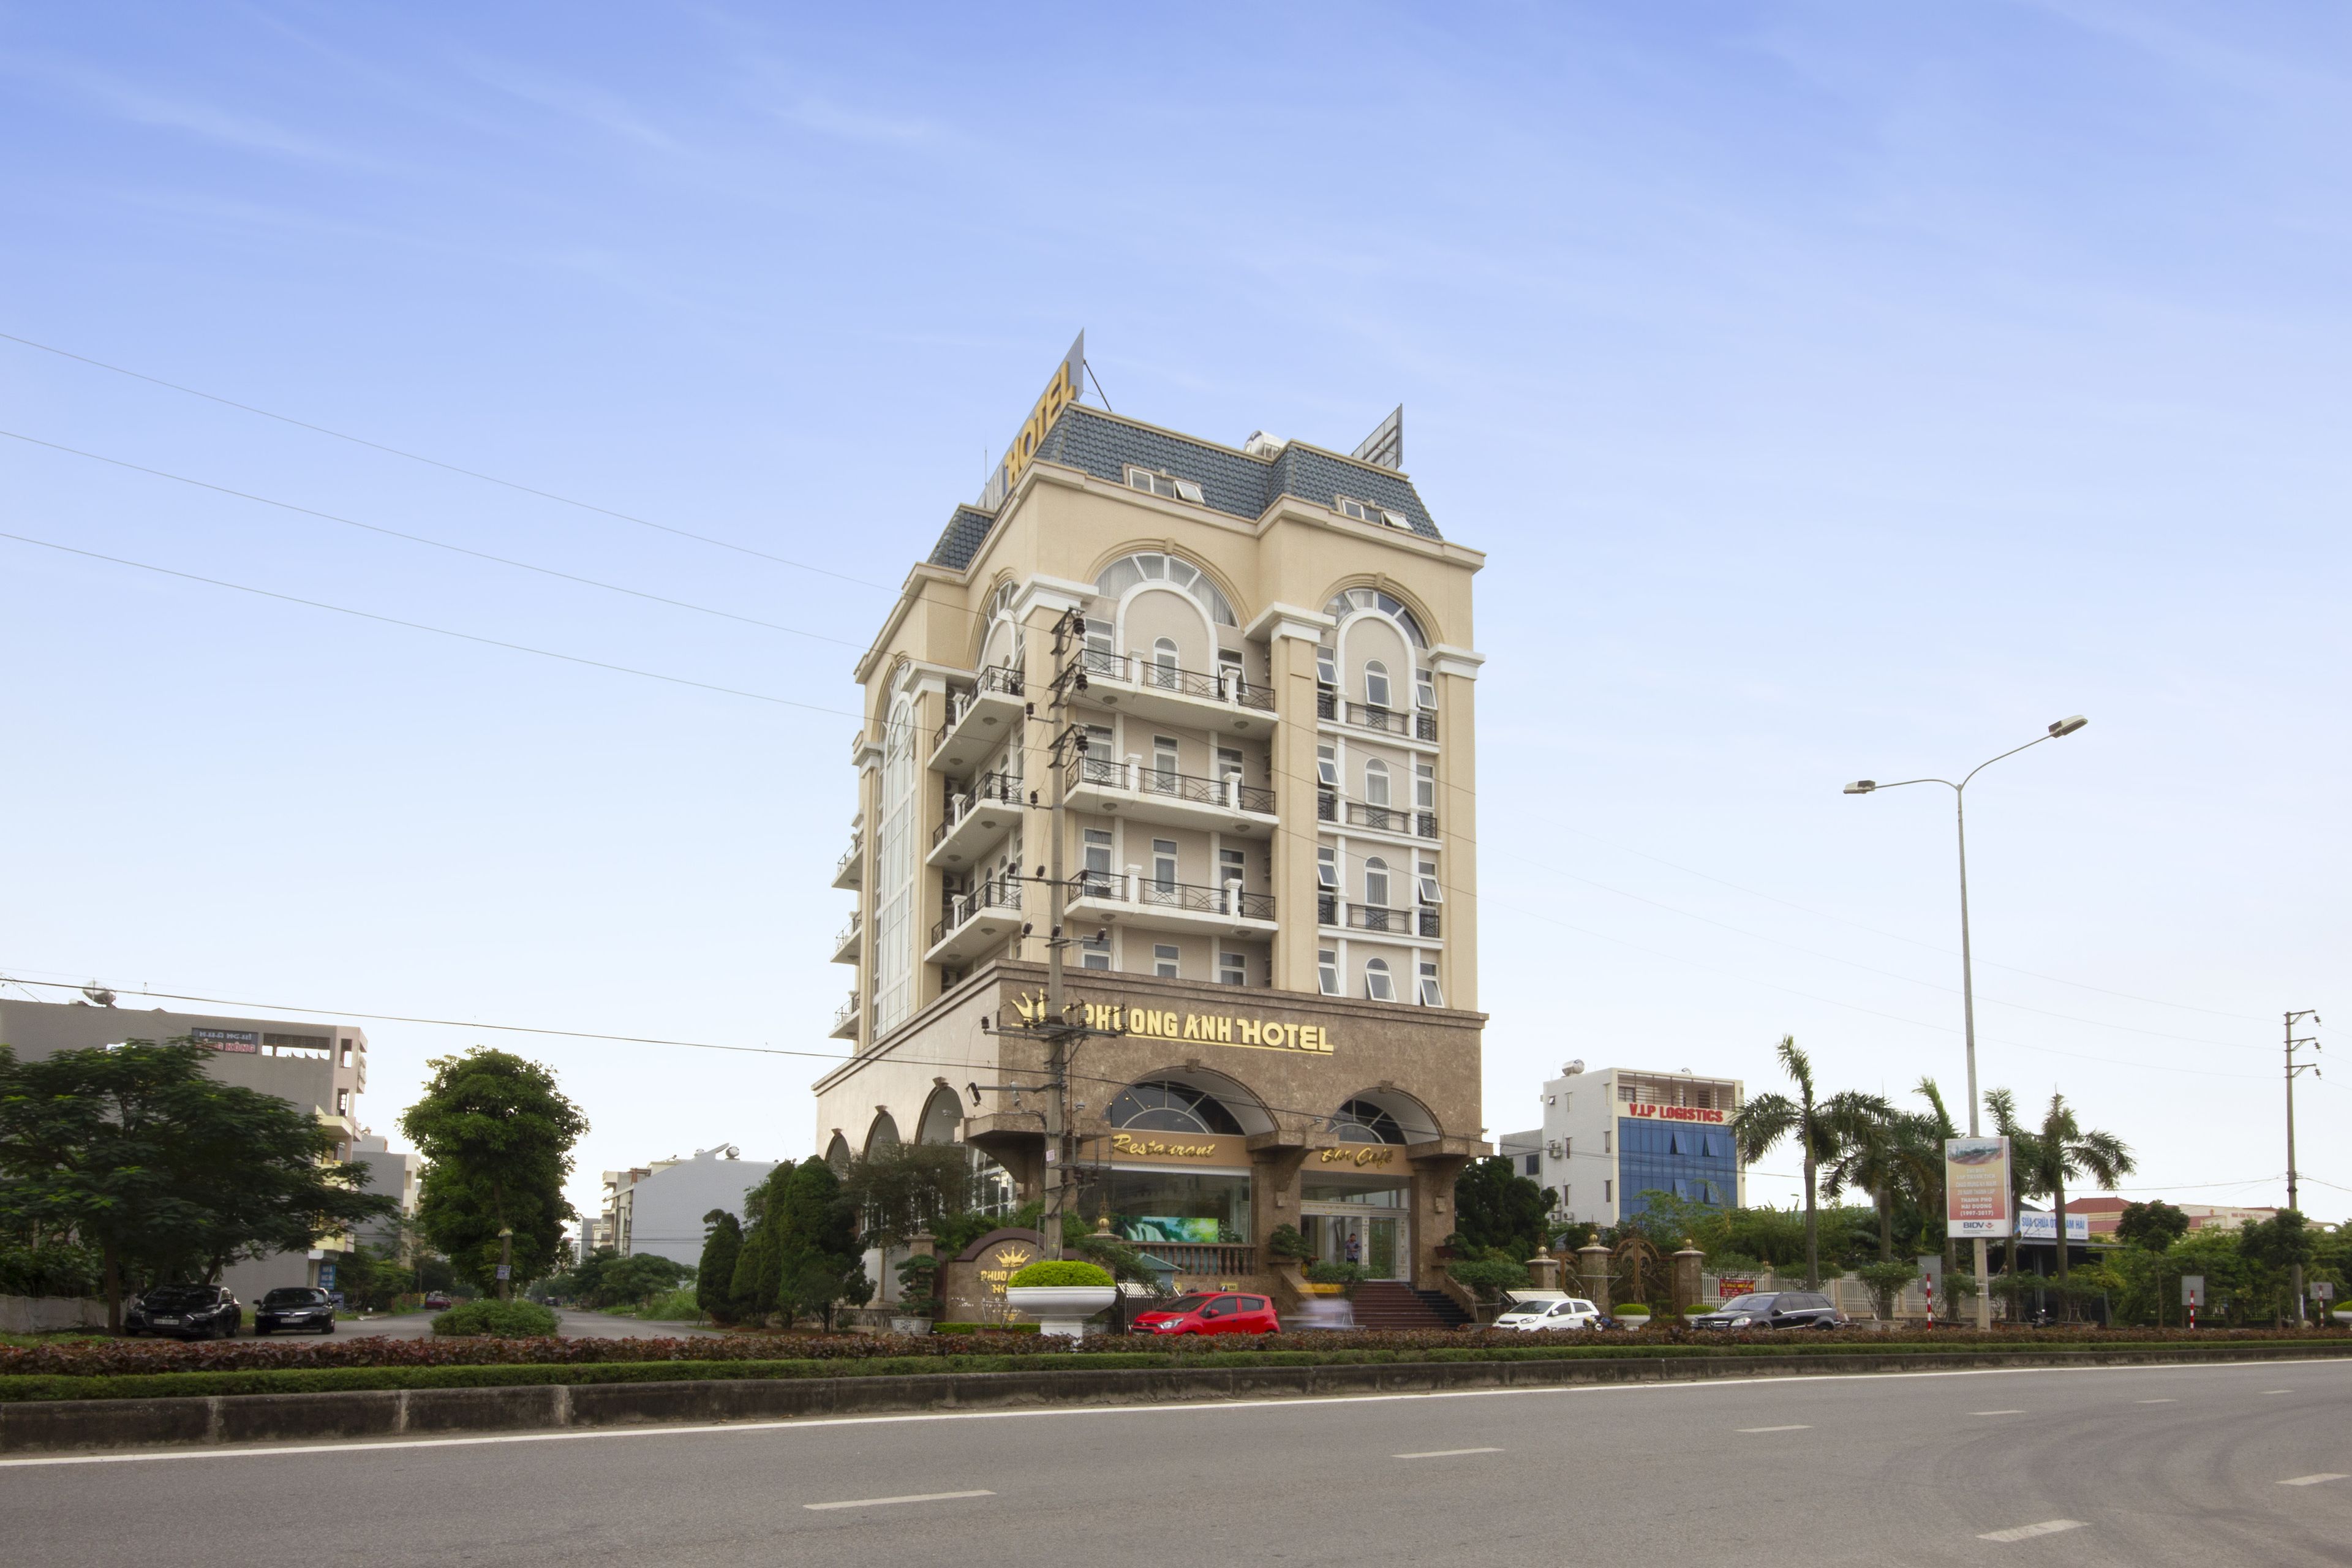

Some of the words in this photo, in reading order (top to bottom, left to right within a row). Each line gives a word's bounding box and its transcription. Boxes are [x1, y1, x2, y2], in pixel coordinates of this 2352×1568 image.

[1005, 360, 1076, 490] HOTEL
[1183, 1014, 1232, 1042] ANH
[1236, 1018, 1334, 1052] HOTEL
[1659, 1106, 1724, 1123] LOGISTICS
[1113, 1134, 1216, 1156] Restaurant
